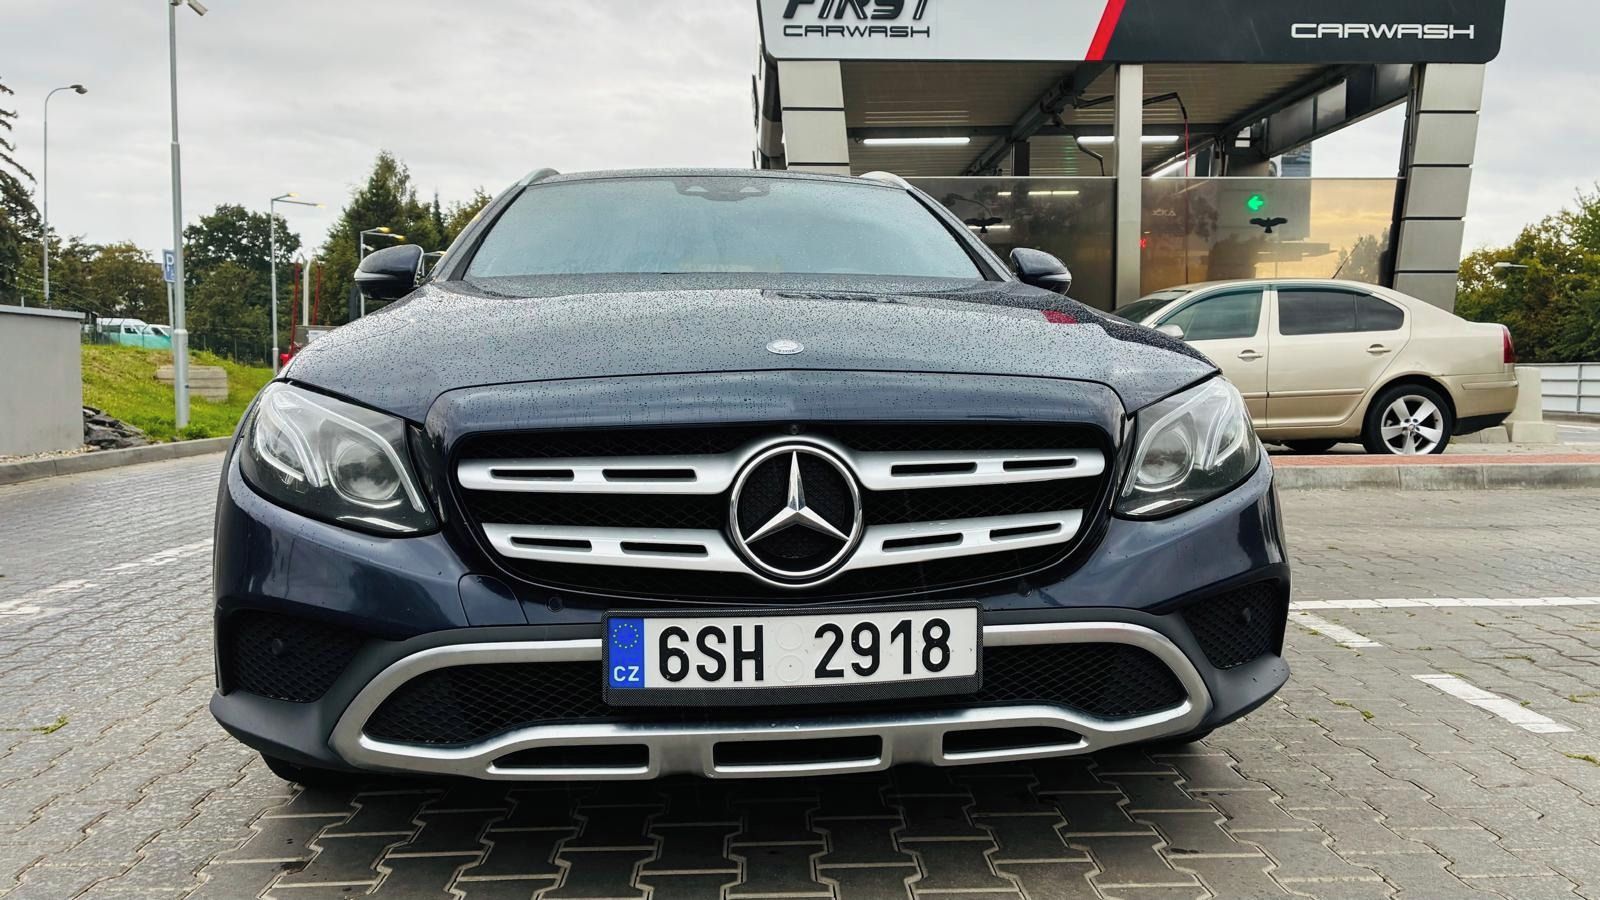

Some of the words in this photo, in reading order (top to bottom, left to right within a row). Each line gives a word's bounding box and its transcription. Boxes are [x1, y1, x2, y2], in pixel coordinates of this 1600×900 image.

[783, 24, 930, 38] CARWASH
[1291, 23, 1475, 40] CARWASH
[658, 624, 765, 683] 6SH
[814, 617, 952, 680] 2918
[613, 665, 640, 682] CZ
